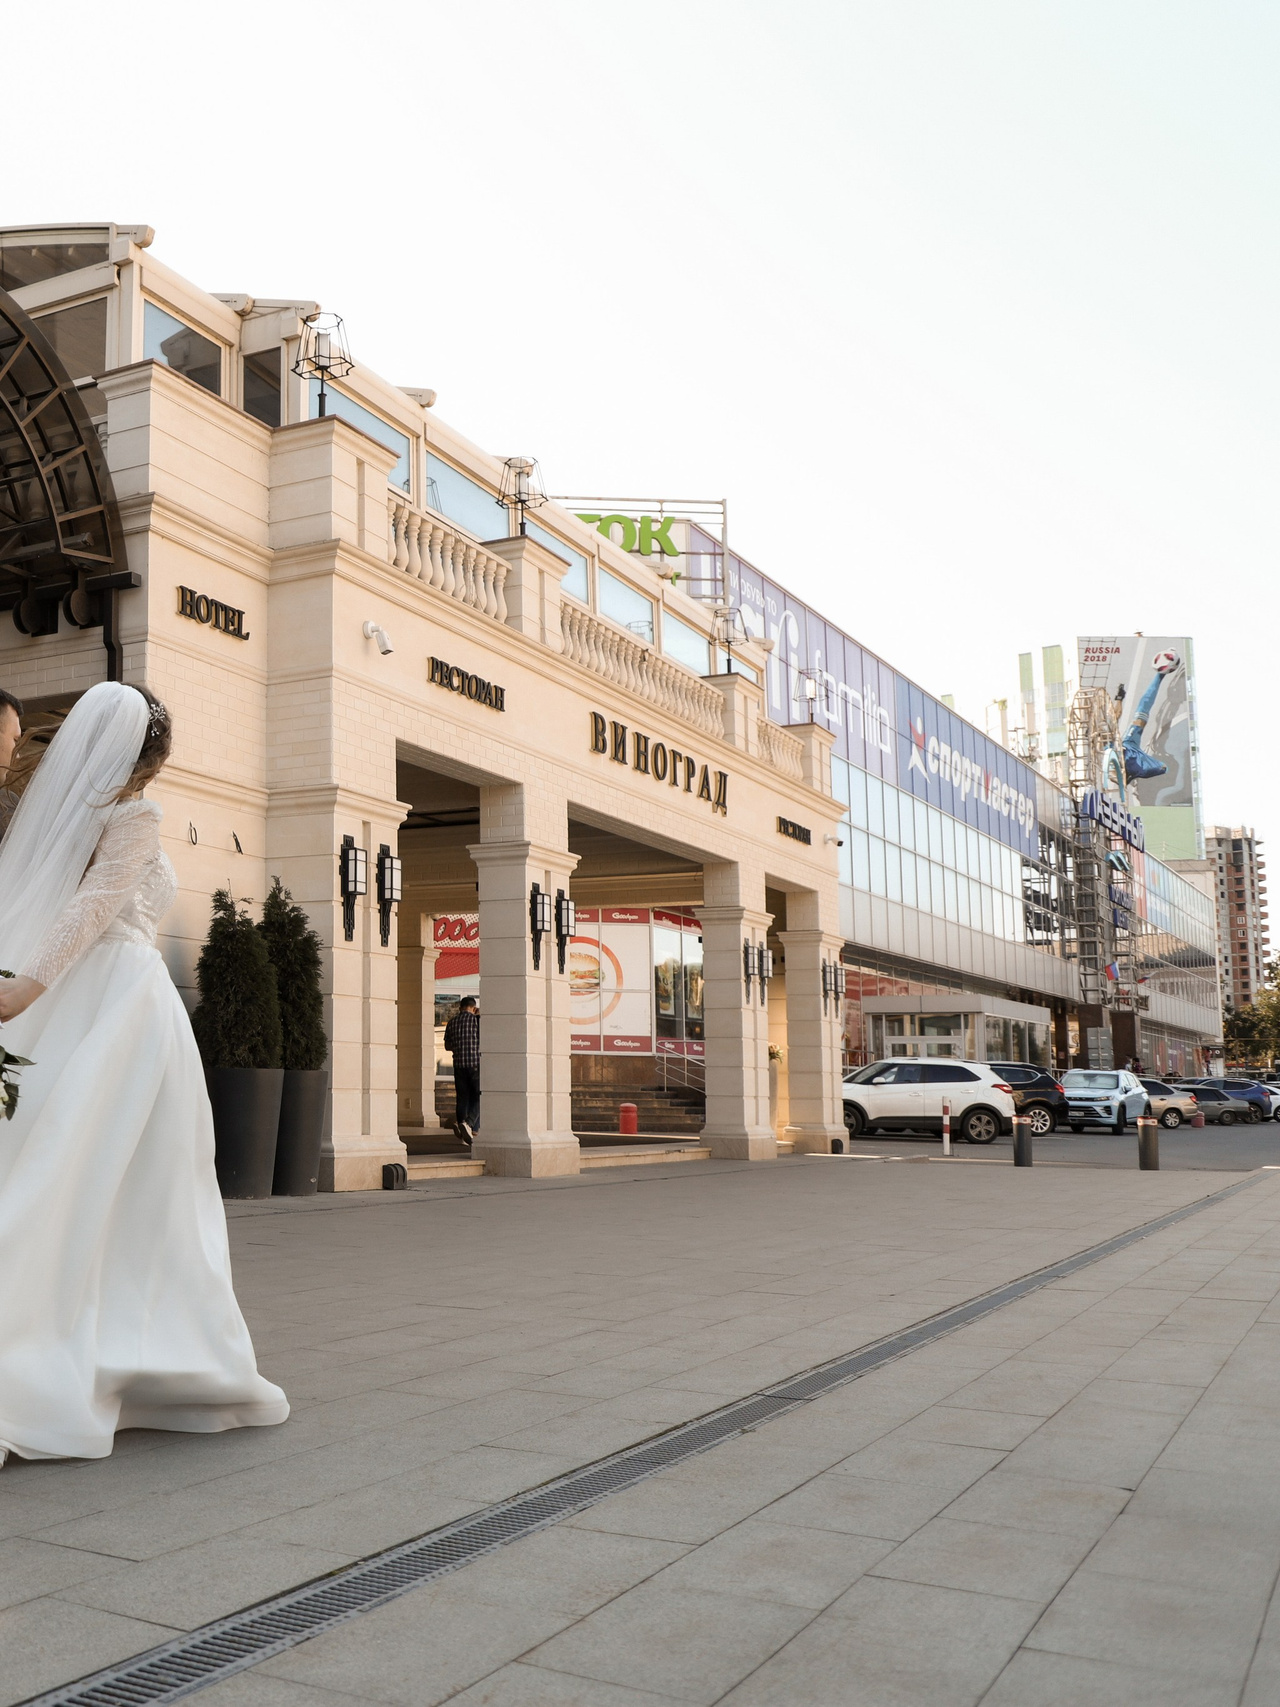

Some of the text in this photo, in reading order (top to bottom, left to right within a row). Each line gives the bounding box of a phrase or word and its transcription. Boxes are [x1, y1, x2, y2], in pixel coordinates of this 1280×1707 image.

[176, 585, 250, 641] HOTEL
[1084, 646, 1121, 655] RUSSIA
[427, 656, 506, 712] РЕСТОРАН
[814, 649, 892, 755] familia
[589, 711, 729, 817] ВИНОГРАД
[927, 715, 1035, 838] спортмастер
